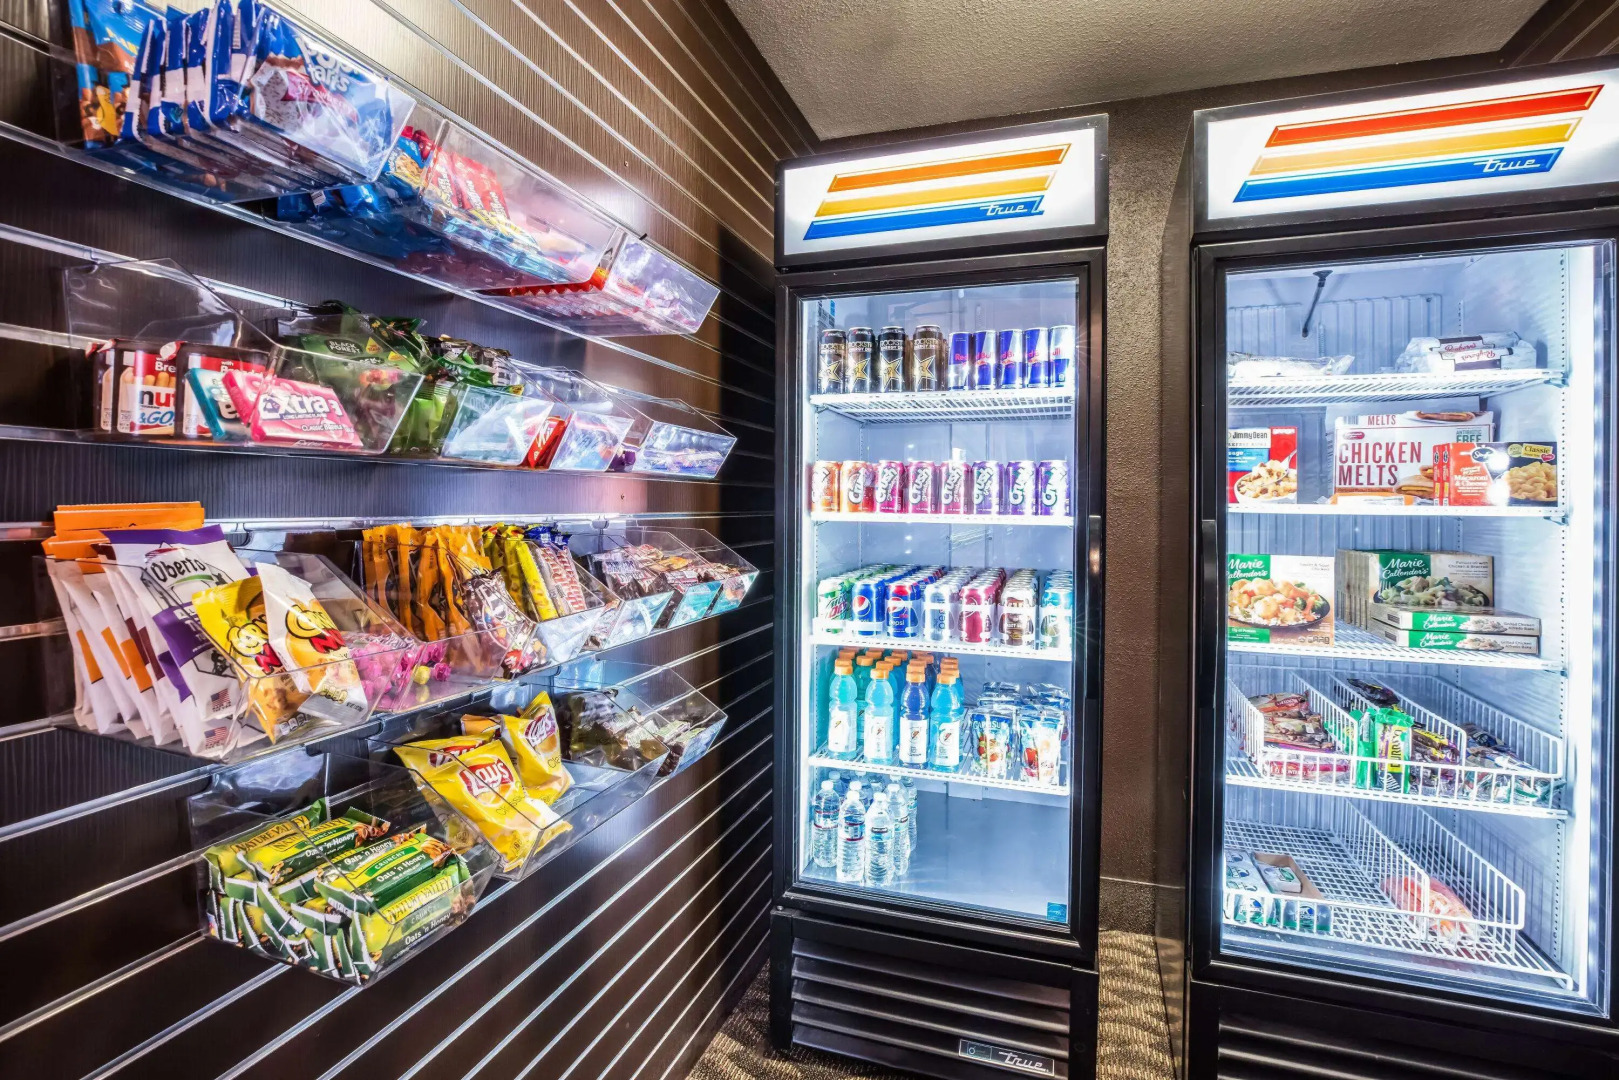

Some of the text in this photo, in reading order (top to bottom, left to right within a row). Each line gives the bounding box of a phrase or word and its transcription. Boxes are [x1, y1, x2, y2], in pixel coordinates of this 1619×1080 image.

[329, 345, 360, 354] FOREST
[1367, 415, 1396, 426] MELTS
[1339, 441, 1422, 464] CHICKEN
[1338, 465, 1398, 486] MELTS
[151, 558, 206, 582] Oberto
[1228, 559, 1264, 569] Marie
[1385, 559, 1425, 570] Marie
[1428, 614, 1454, 622] Marie
[464, 759, 509, 798] Lay's
[235, 828, 275, 852] NATURE
[333, 832, 355, 846] Honey
[344, 853, 363, 866] Oats
[370, 841, 393, 856] Honey
[374, 851, 406, 870] CRUNCHY
[376, 870, 393, 882] Oats
[405, 853, 426, 868] Honey
[387, 893, 423, 921] NATURE
[405, 932, 422, 945] Oats
